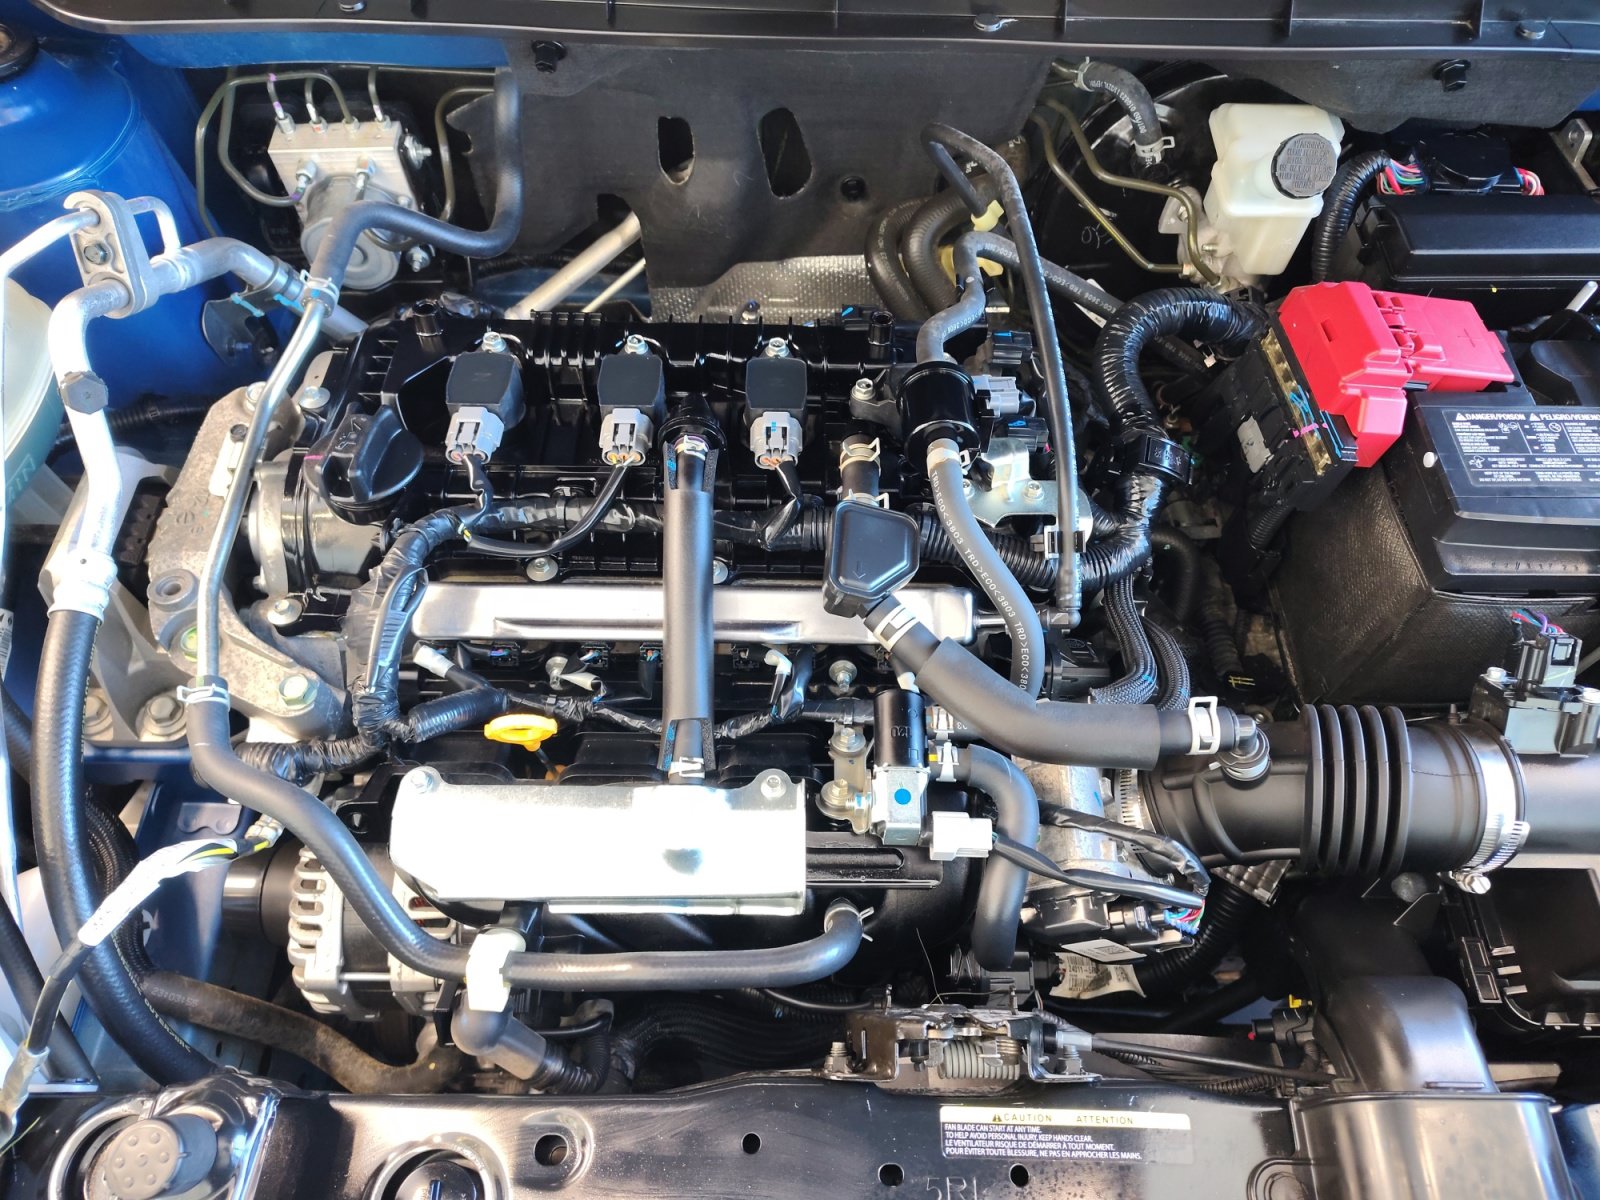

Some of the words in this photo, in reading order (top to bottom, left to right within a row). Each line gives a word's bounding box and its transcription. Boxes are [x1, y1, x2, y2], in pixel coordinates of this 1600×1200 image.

[1465, 413, 1526, 421] DANGER/POISON
[1013, 622, 1030, 691] TRD>ECO<380
[1004, 1113, 1052, 1123] CAUTION
[1077, 1115, 1134, 1125] ATTENTION
[944, 1123, 956, 1131] FAN
[957, 1124, 975, 1132] BLADE
[976, 1124, 988, 1132] CAN
[945, 1131, 954, 1139] TO
[955, 1131, 969, 1139] HELP
[988, 1132, 1017, 1140] PERSONAL
[1039, 1134, 1053, 1142] KEEP
[1053, 1134, 1073, 1142] HANDS
[954, 1140, 994, 1148] VENTILATEUR
[995, 1141, 1018, 1149] RISQUE
[1018, 1141, 1028, 1149] DE
[1028, 1141, 1061, 1149] DÉMARRER
[1085, 1143, 1116, 1151] MOMENT.
[946, 1147, 965, 1155] POUR
[965, 1147, 986, 1156] ÉVITER
[986, 1148, 1007, 1156] TOUTE
[1007, 1149, 1039, 1157] BLESSURE,
[1061, 1150, 1071, 1158] EN
[1071, 1151, 1109, 1159] APPROCHER
[1109, 1151, 1120, 1159] LES
